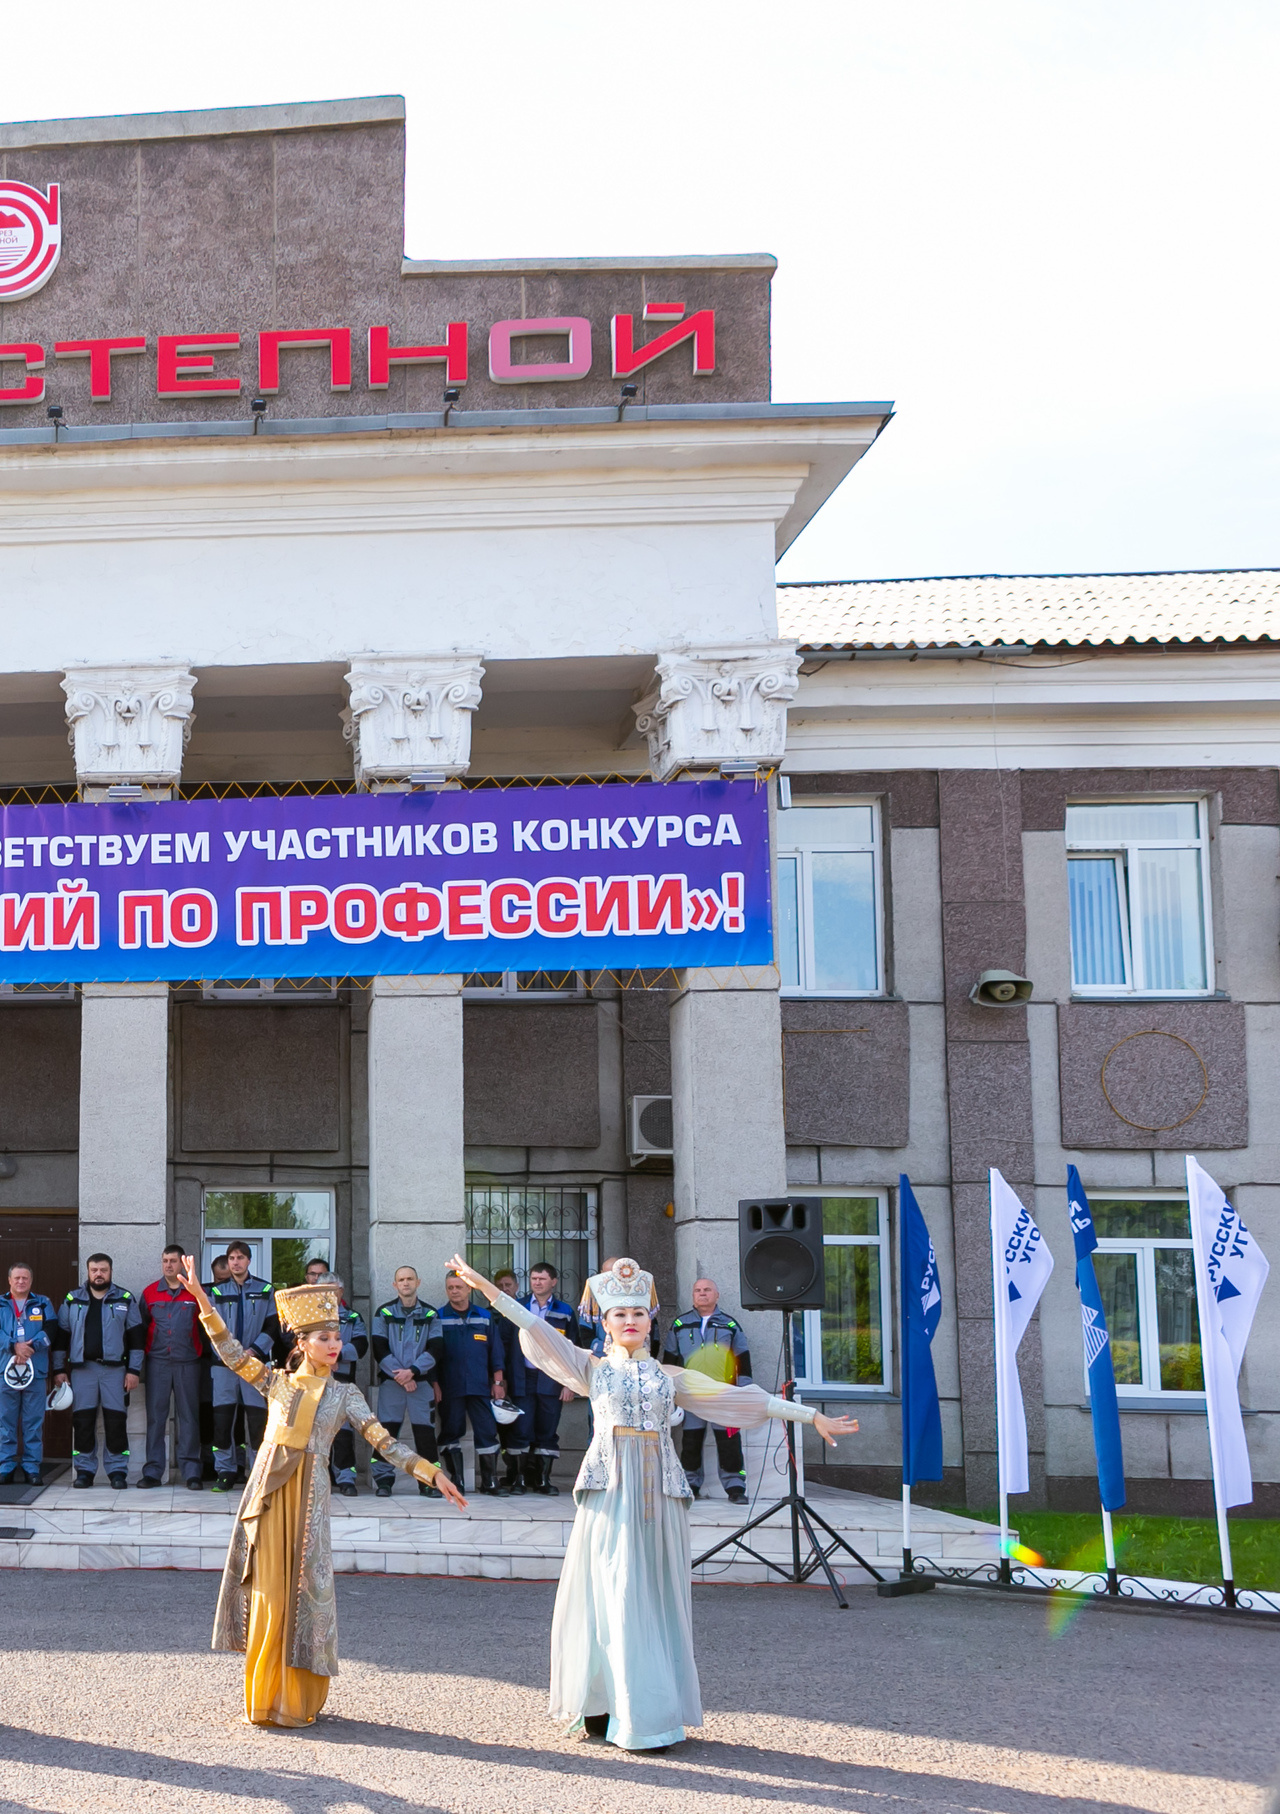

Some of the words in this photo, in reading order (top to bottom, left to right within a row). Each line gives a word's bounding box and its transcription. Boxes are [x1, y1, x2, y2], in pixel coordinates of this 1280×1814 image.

[224, 822, 498, 862] УЧАСТНИКОВ
[513, 814, 742, 852] КОНКУРСА
[119, 888, 218, 947] ПО
[235, 872, 745, 946] ПРОФЕССИИ»!
